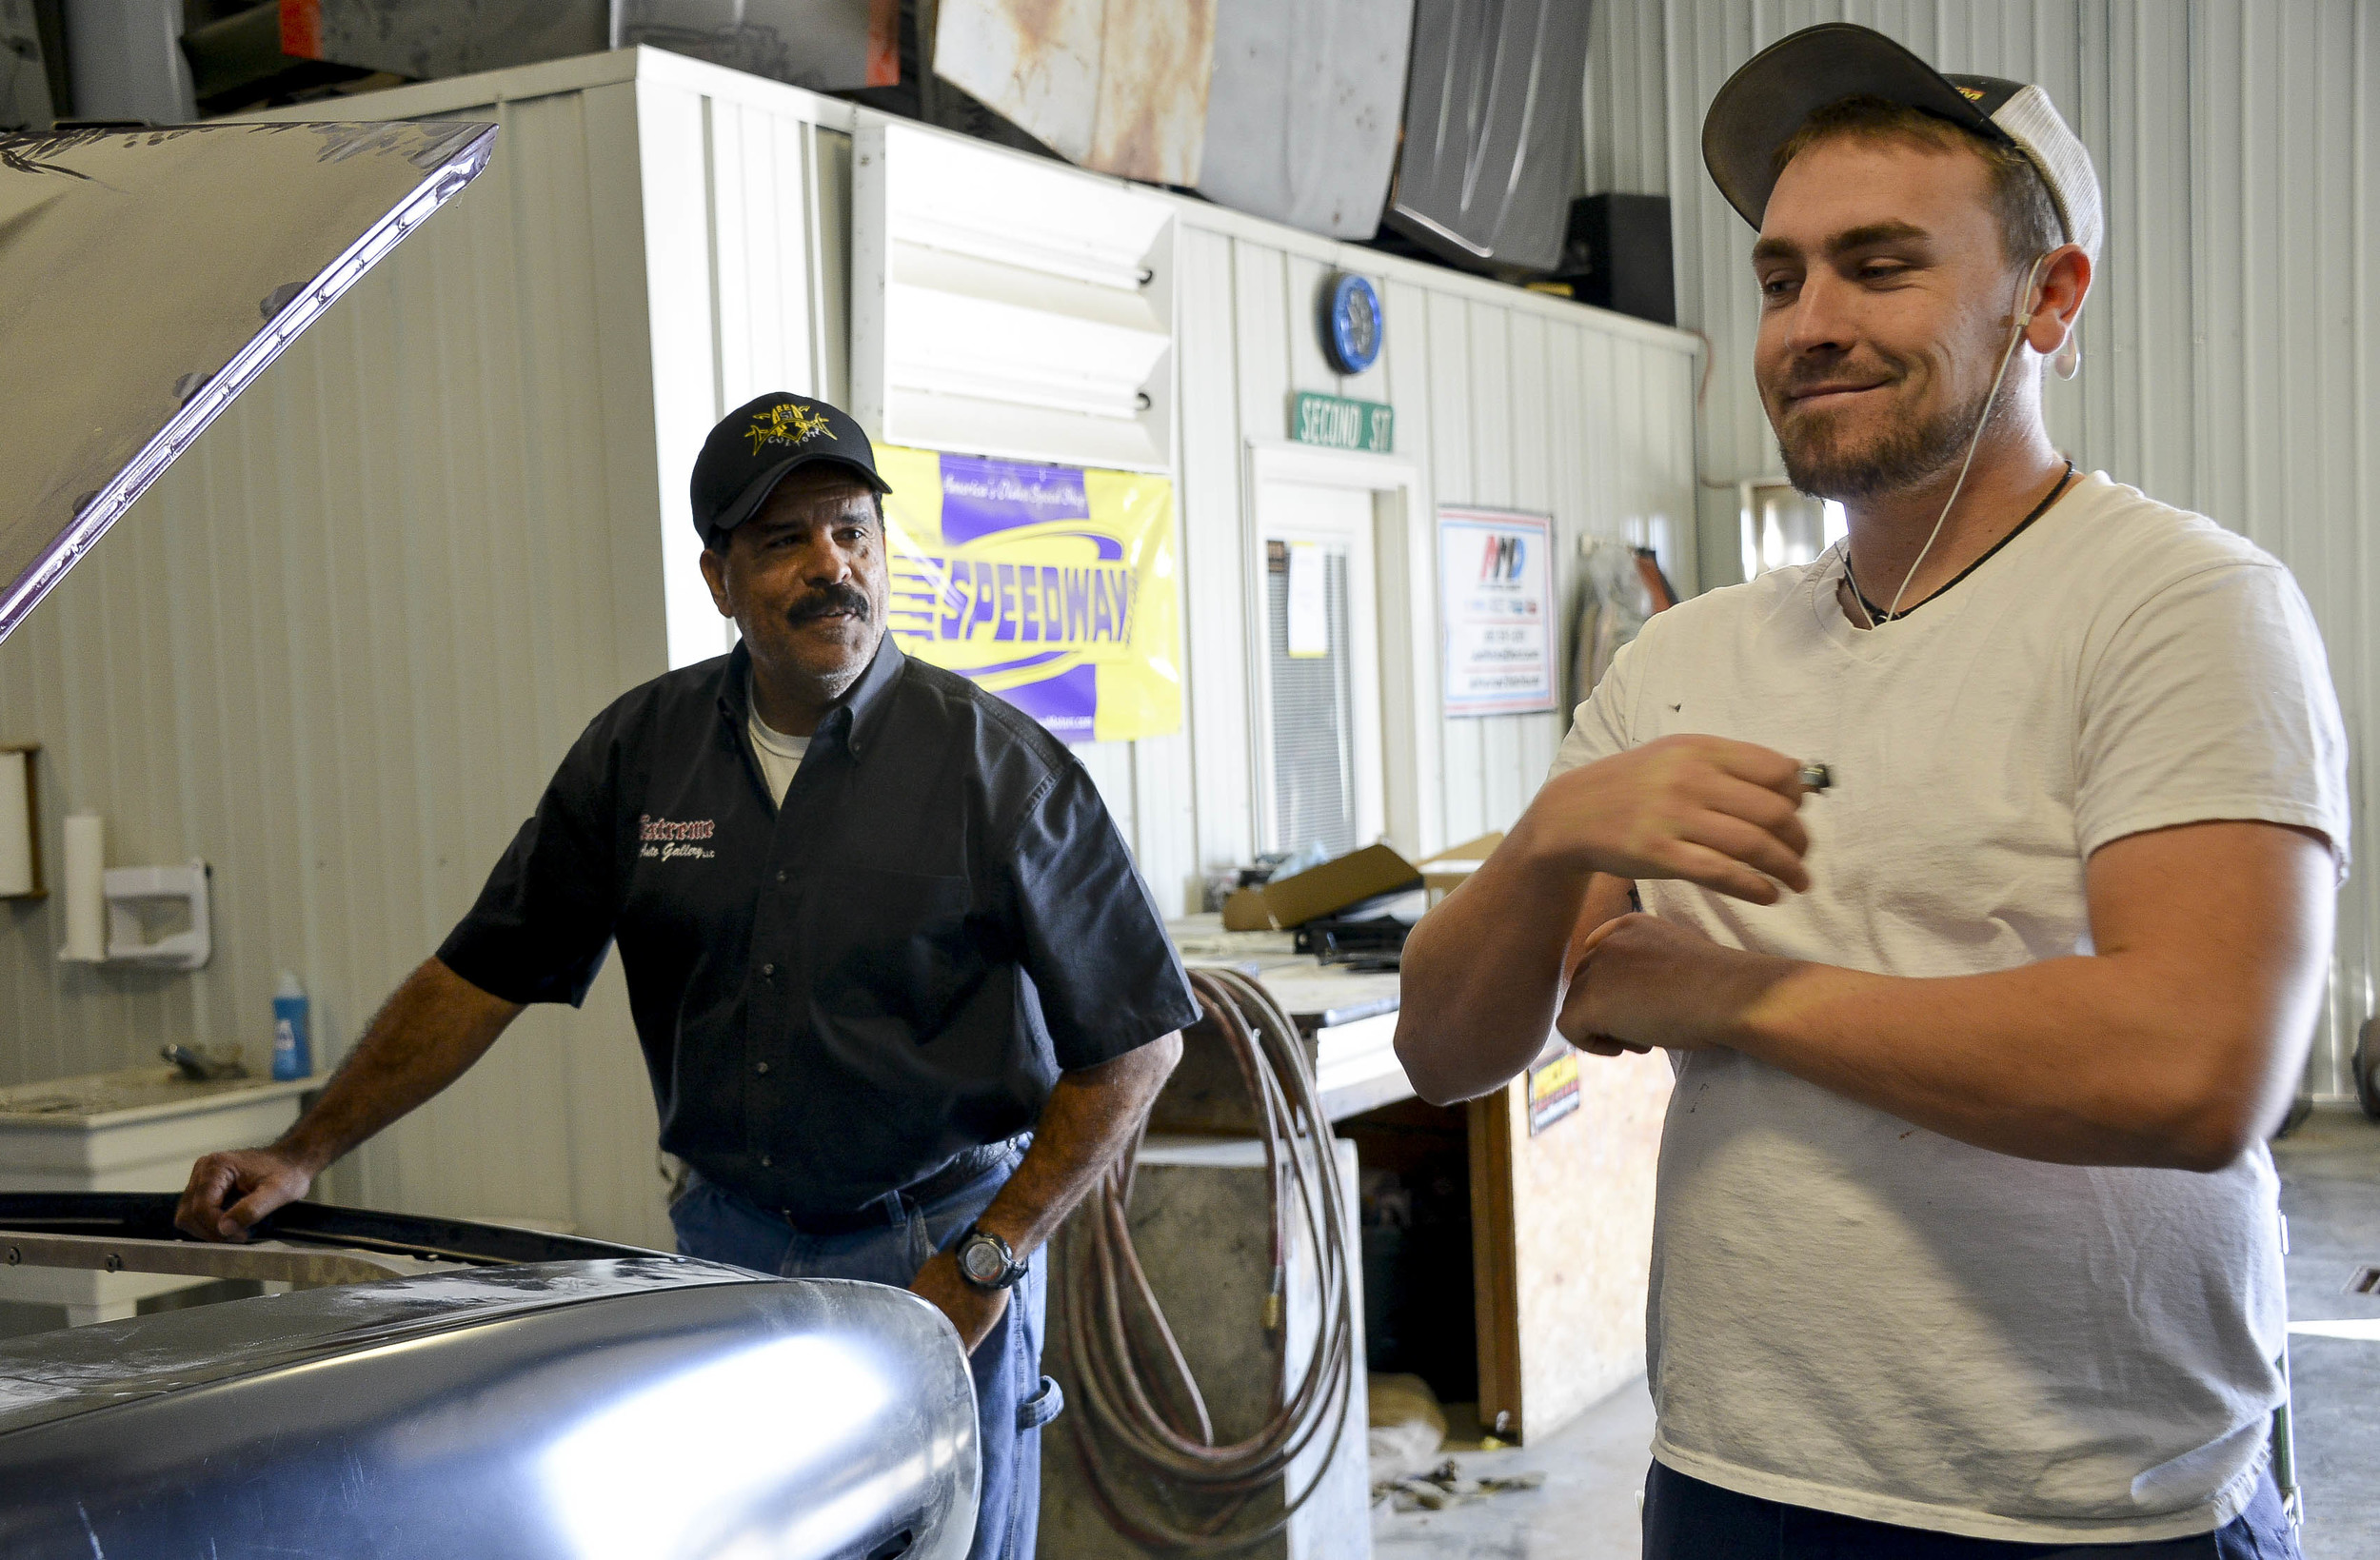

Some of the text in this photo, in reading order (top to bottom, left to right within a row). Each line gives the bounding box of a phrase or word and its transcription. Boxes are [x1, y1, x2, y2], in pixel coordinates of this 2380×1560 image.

[1300, 397, 1391, 453] SECOND ST
[940, 559, 1127, 642] SPEEDWAY
[662, 842, 703, 861] Gallery
